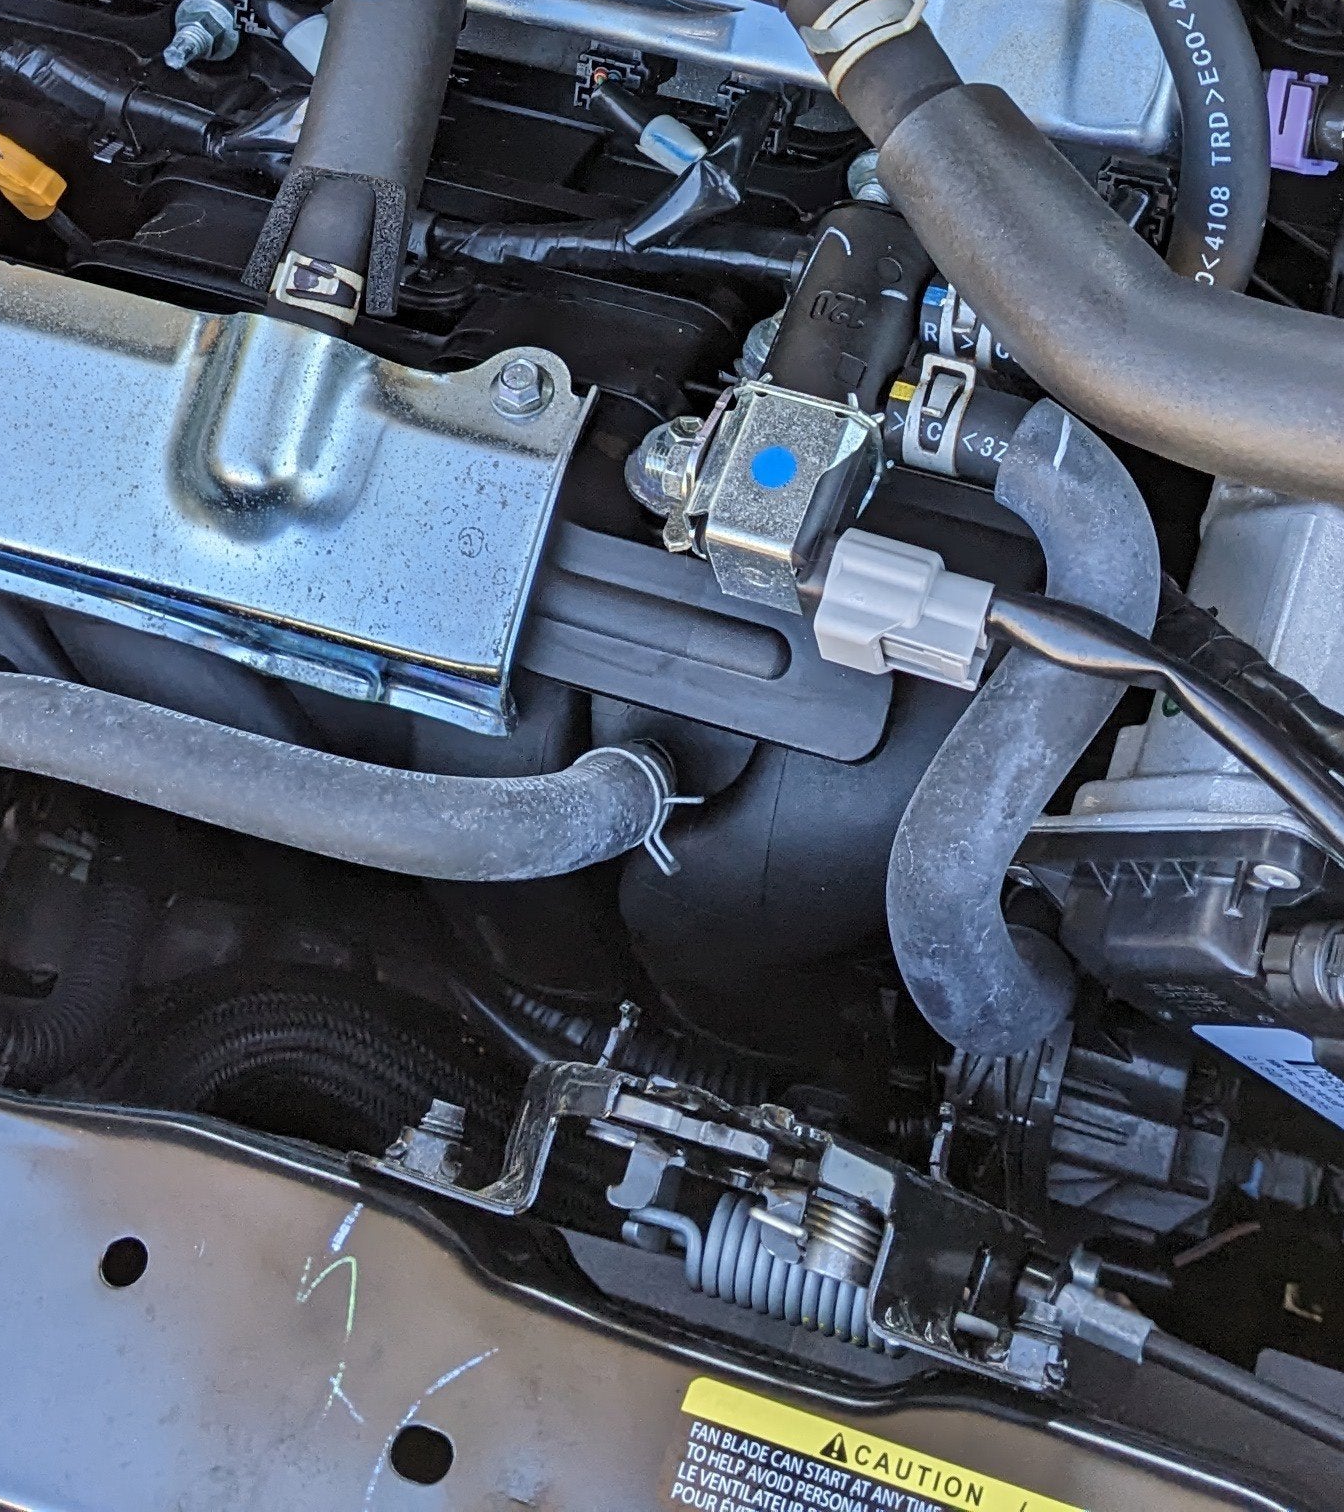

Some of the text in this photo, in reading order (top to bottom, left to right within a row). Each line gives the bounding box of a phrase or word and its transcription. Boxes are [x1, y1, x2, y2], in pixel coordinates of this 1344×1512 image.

[677, 1461, 698, 1483] LE
[687, 1441, 708, 1463] TO
[707, 1450, 746, 1475] HELP
[745, 1464, 794, 1494] AVOID
[690, 1421, 721, 1445] FAN
[721, 1432, 770, 1463] BLADE
[770, 1450, 804, 1475] CAN
[803, 1461, 851, 1490] START
[849, 1478, 872, 1498] AT
[870, 1485, 905, 1510] ANY
[854, 1444, 985, 1507] CAUTION
[670, 1481, 718, 1512] POUR
